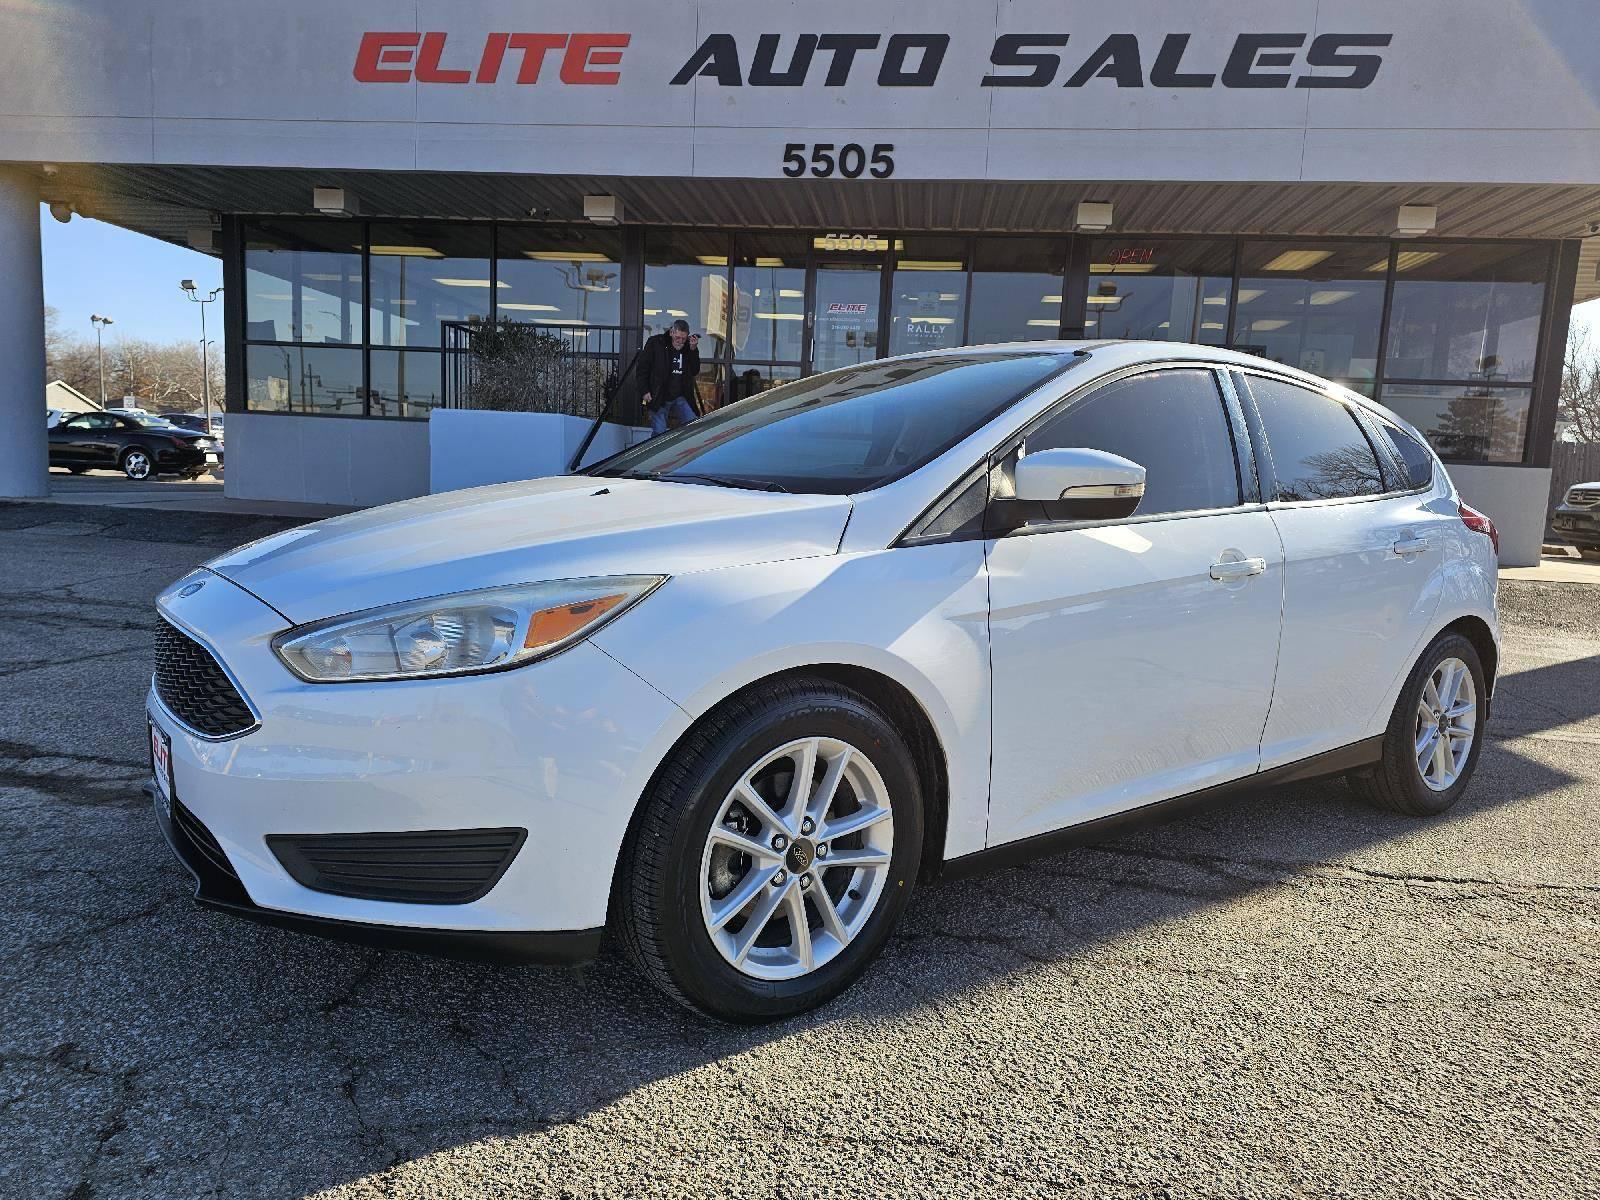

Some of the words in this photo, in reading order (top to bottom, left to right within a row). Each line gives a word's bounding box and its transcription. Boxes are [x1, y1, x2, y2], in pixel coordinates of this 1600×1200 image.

[353, 32, 631, 85] ELITE
[669, 33, 950, 87] AUTO
[980, 33, 1393, 88] SALES
[782, 143, 895, 179] 5505
[825, 233, 878, 252] 5505
[1110, 247, 1154, 265] OPEN
[829, 303, 868, 312] ELITE
[907, 323, 946, 334] RALLY
[154, 733, 169, 772] ELIT
